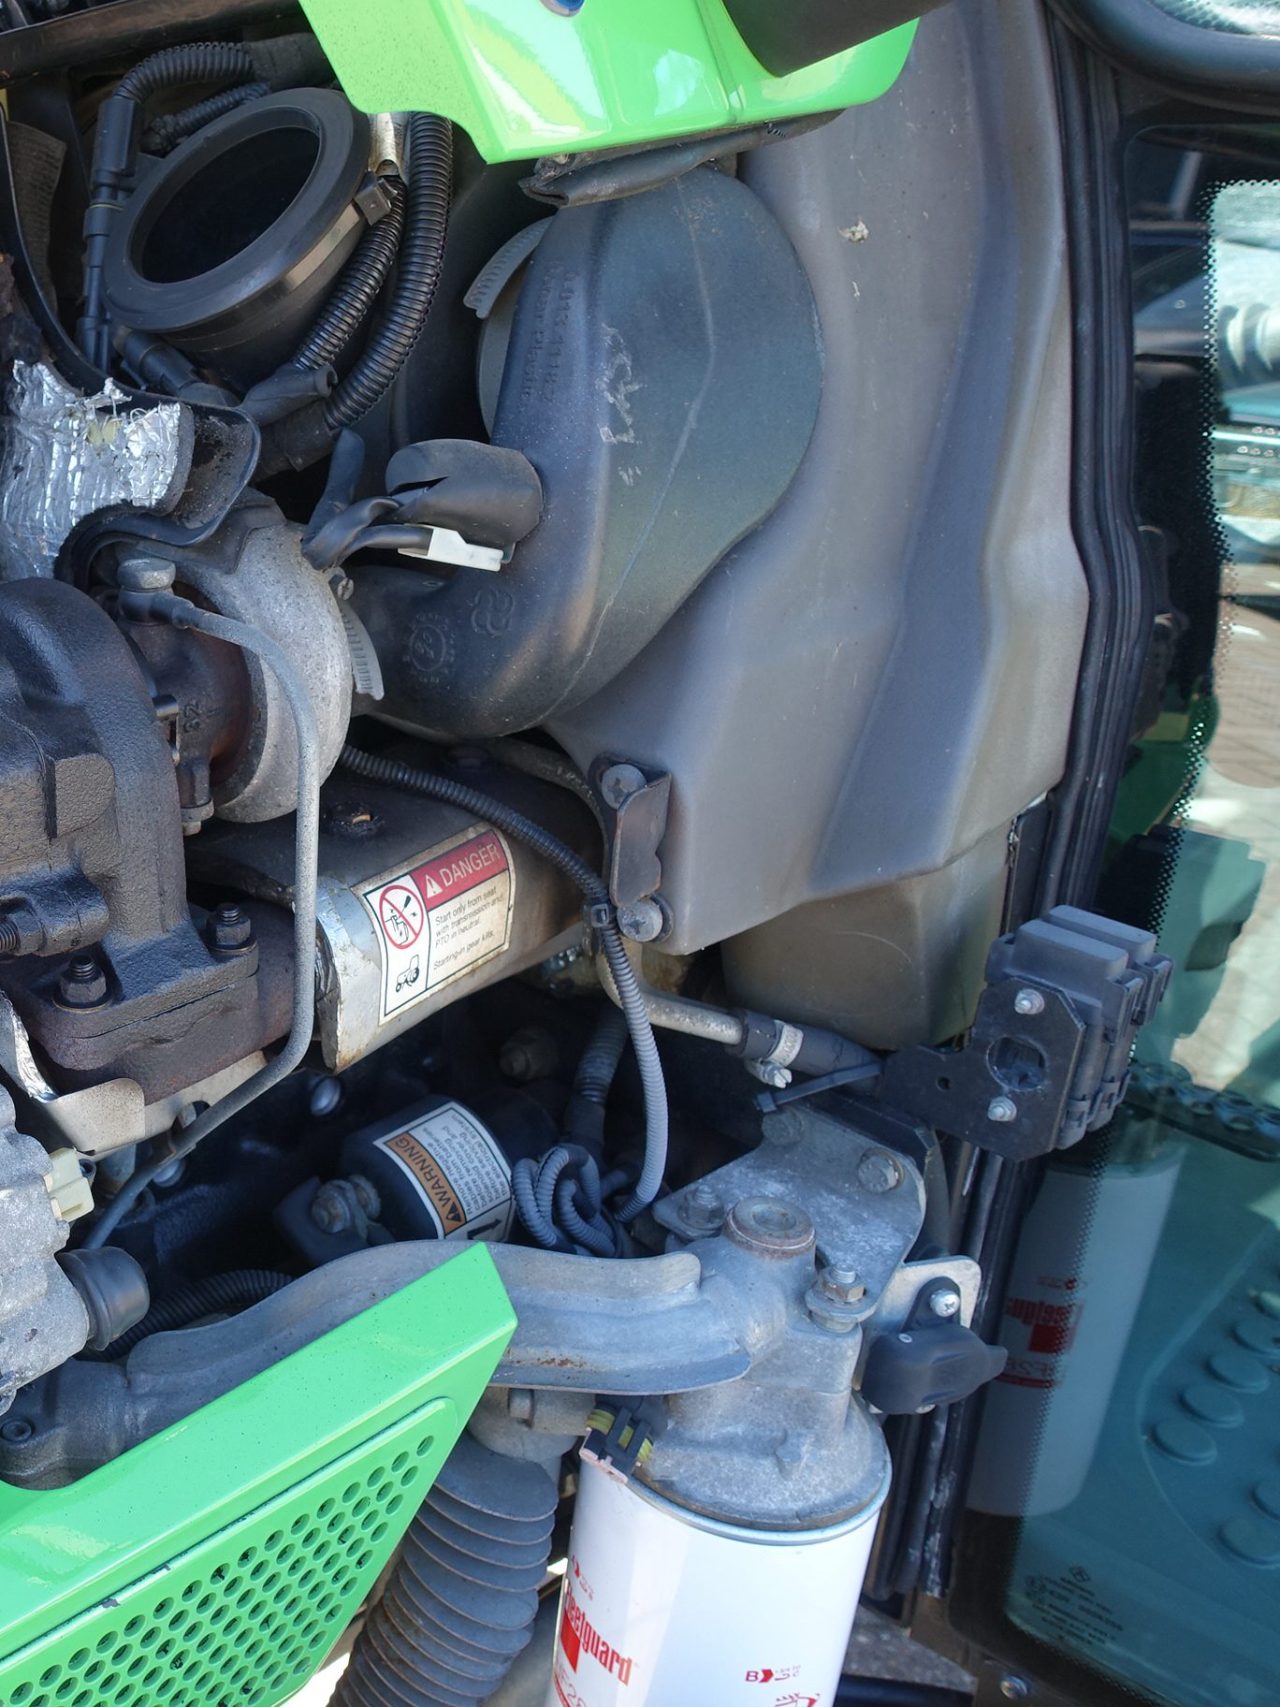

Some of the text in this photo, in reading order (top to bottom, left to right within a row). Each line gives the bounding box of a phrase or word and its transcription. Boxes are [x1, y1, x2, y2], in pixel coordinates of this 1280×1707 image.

[439, 843, 501, 887] DANGER
[436, 911, 451, 926] Start
[453, 902, 466, 917] only
[467, 895, 482, 909] from
[395, 1135, 452, 1207] WARNING
